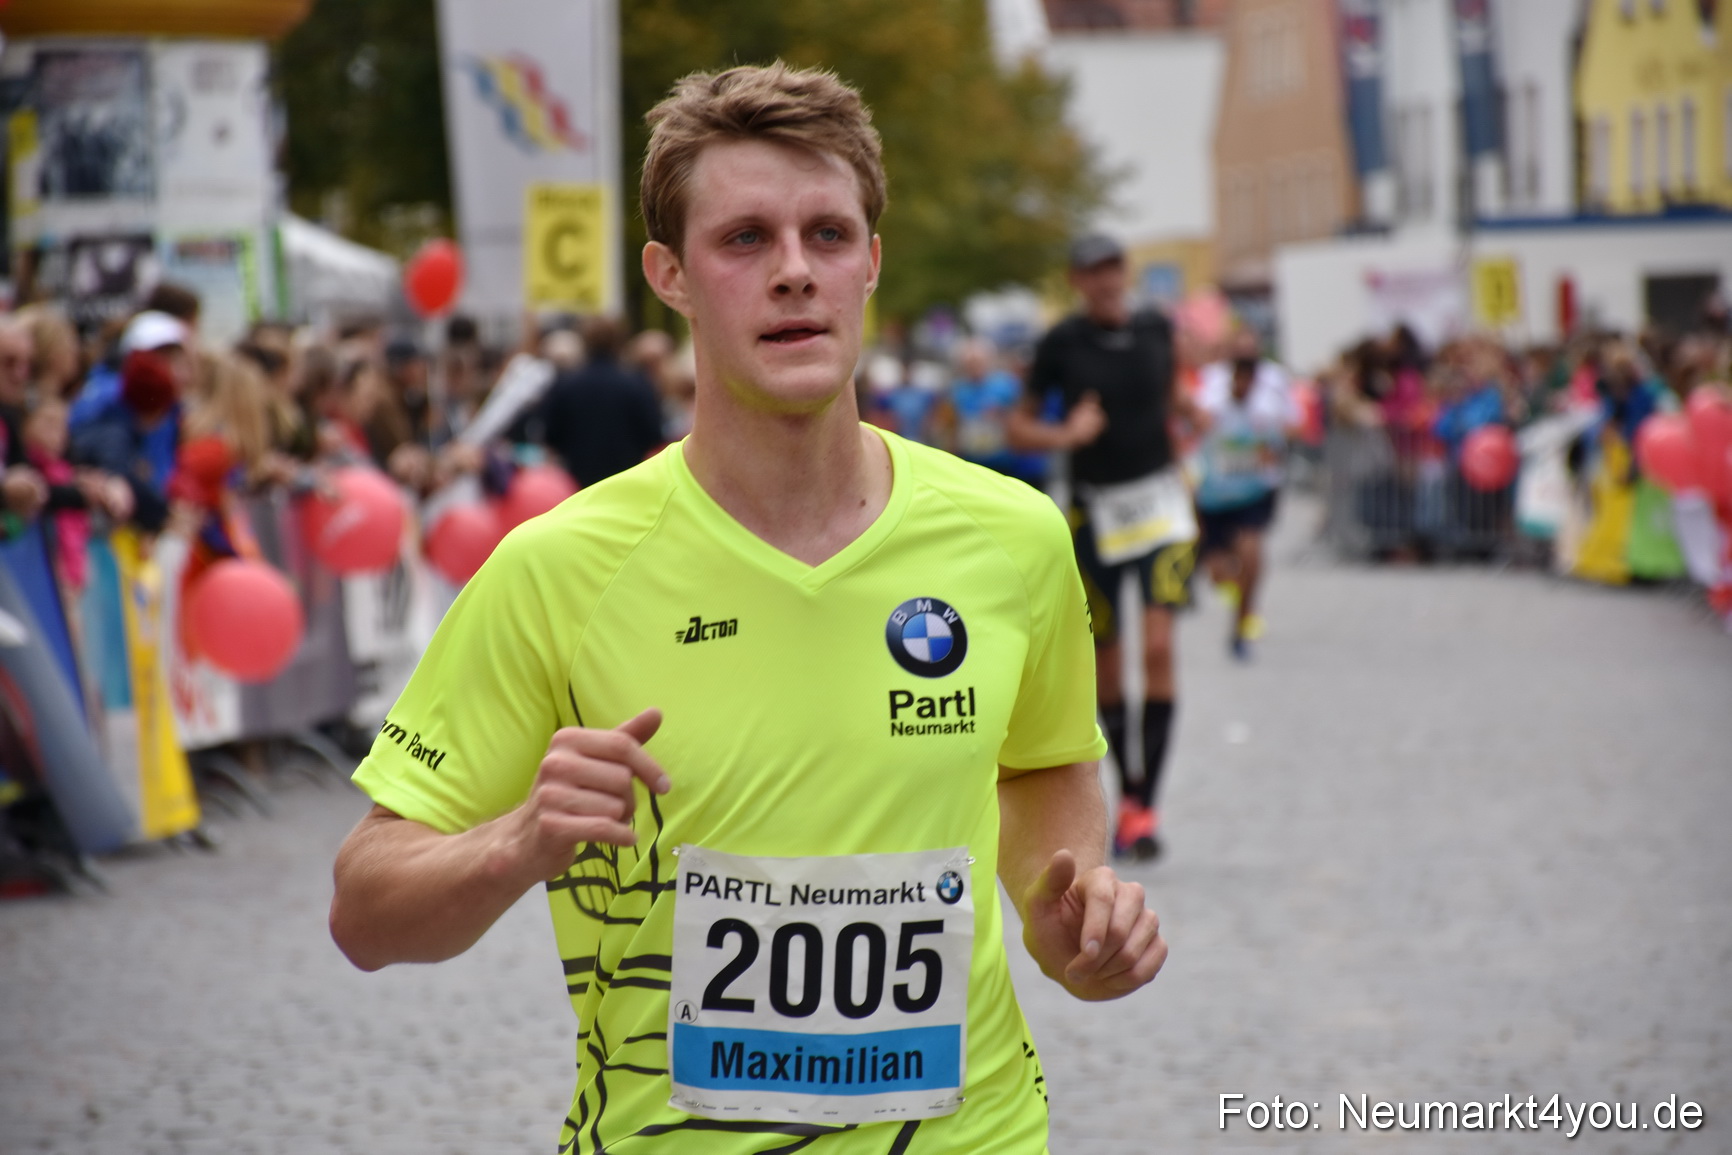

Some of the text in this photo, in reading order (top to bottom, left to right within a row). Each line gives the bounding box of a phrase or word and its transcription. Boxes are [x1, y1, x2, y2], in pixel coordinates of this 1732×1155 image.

[891, 599, 959, 626] BMW
[889, 687, 976, 720] Partl
[891, 719, 976, 737] Neumarkt
[406, 732, 447, 771] Partl
[685, 872, 926, 906] PARTL Neumarkt
[701, 918, 945, 1019] 2005
[681, 1004, 692, 1021] A
[710, 1041, 924, 1084] Maximilian
